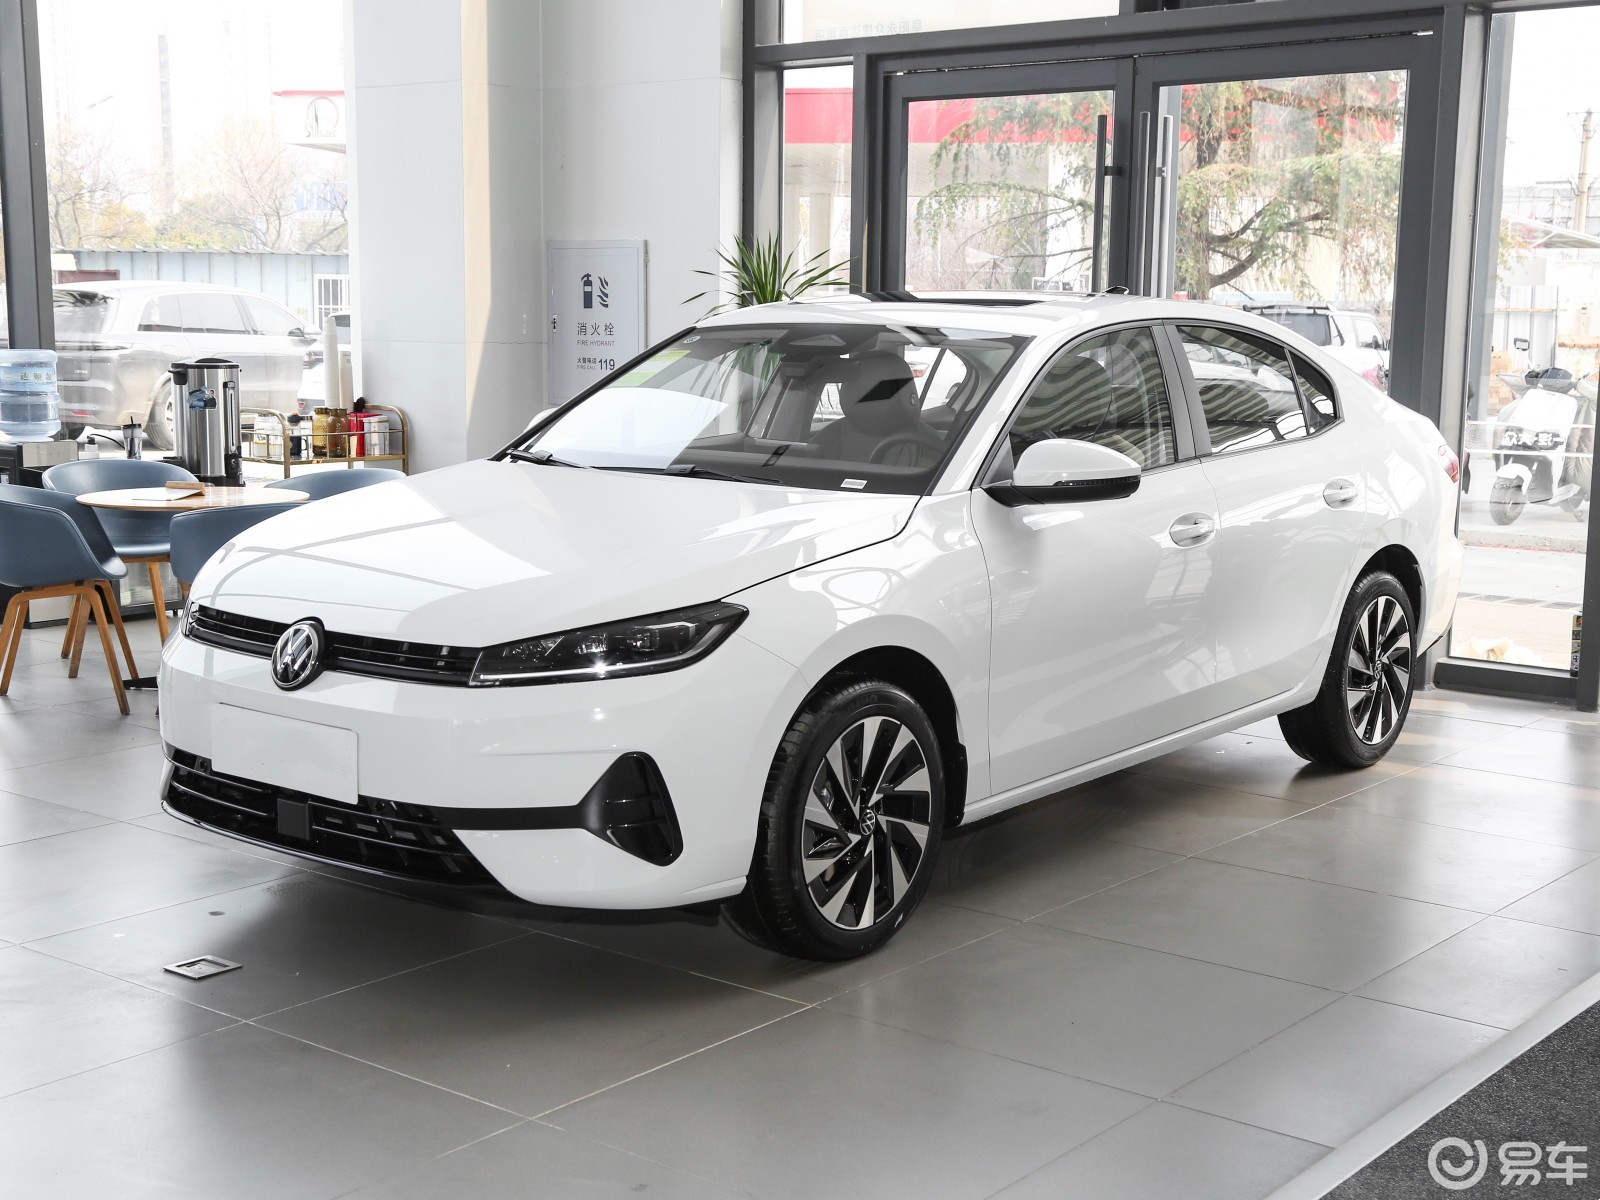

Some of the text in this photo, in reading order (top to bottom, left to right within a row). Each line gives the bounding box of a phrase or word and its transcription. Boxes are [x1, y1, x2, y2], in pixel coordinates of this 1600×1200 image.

[577, 322, 615, 336] 消火栓
[598, 358, 616, 371] 119
